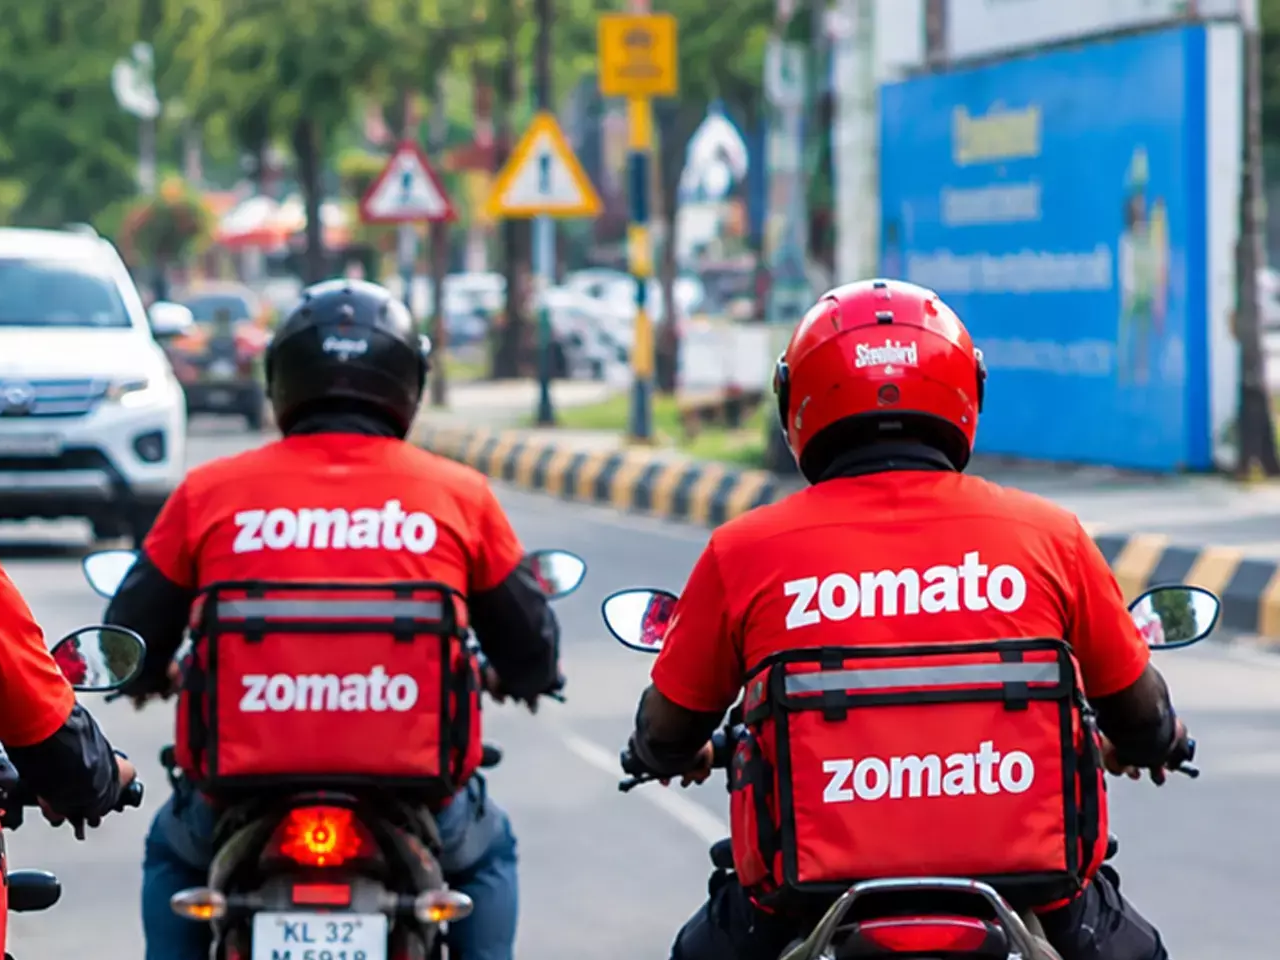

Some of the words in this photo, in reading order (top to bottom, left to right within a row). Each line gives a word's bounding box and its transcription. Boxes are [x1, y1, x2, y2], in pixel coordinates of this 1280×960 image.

[233, 499, 438, 554] zomato
[784, 551, 1027, 629] zomato
[239, 665, 419, 711] zomato
[822, 740, 1035, 803] zomato
[283, 921, 315, 943] KL
[325, 921, 355, 943] 32
